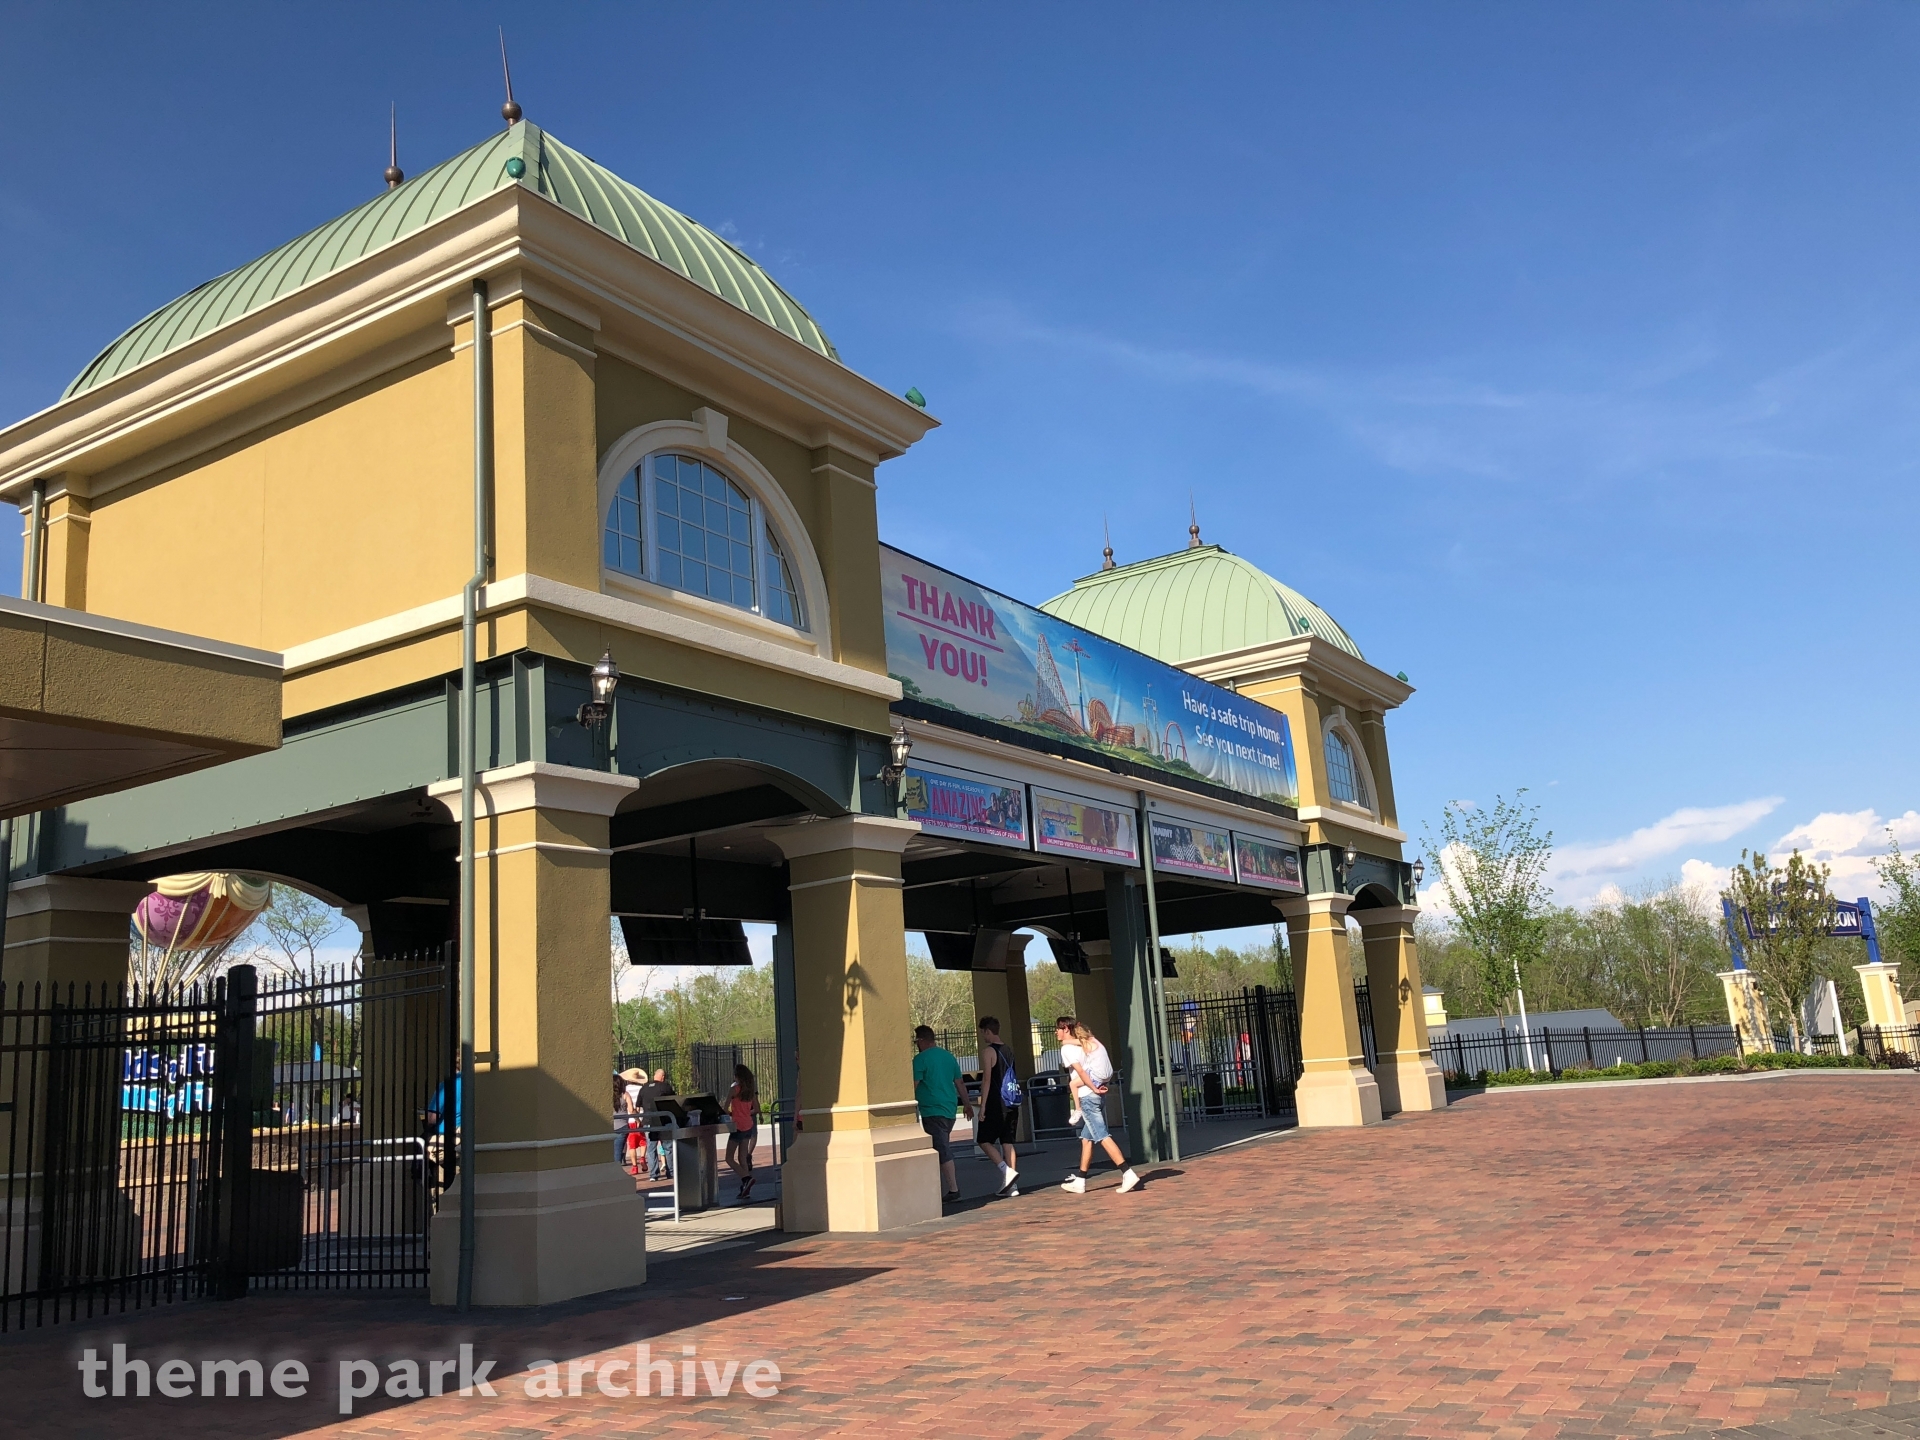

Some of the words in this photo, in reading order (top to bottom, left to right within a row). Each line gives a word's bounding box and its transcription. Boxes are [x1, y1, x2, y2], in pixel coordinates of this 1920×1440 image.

[902, 573, 996, 640] THANK
[919, 633, 988, 687] YOU!
[1182, 690, 1209, 718] Have
[1210, 706, 1217, 721] a
[1218, 708, 1238, 729] safe
[1238, 713, 1255, 739] trip
[1256, 718, 1285, 746] home.
[1195, 725, 1214, 749] See
[1215, 737, 1235, 756] you
[1235, 744, 1257, 762] next
[1257, 748, 1281, 771] time!
[931, 787, 988, 822] AMAZING
